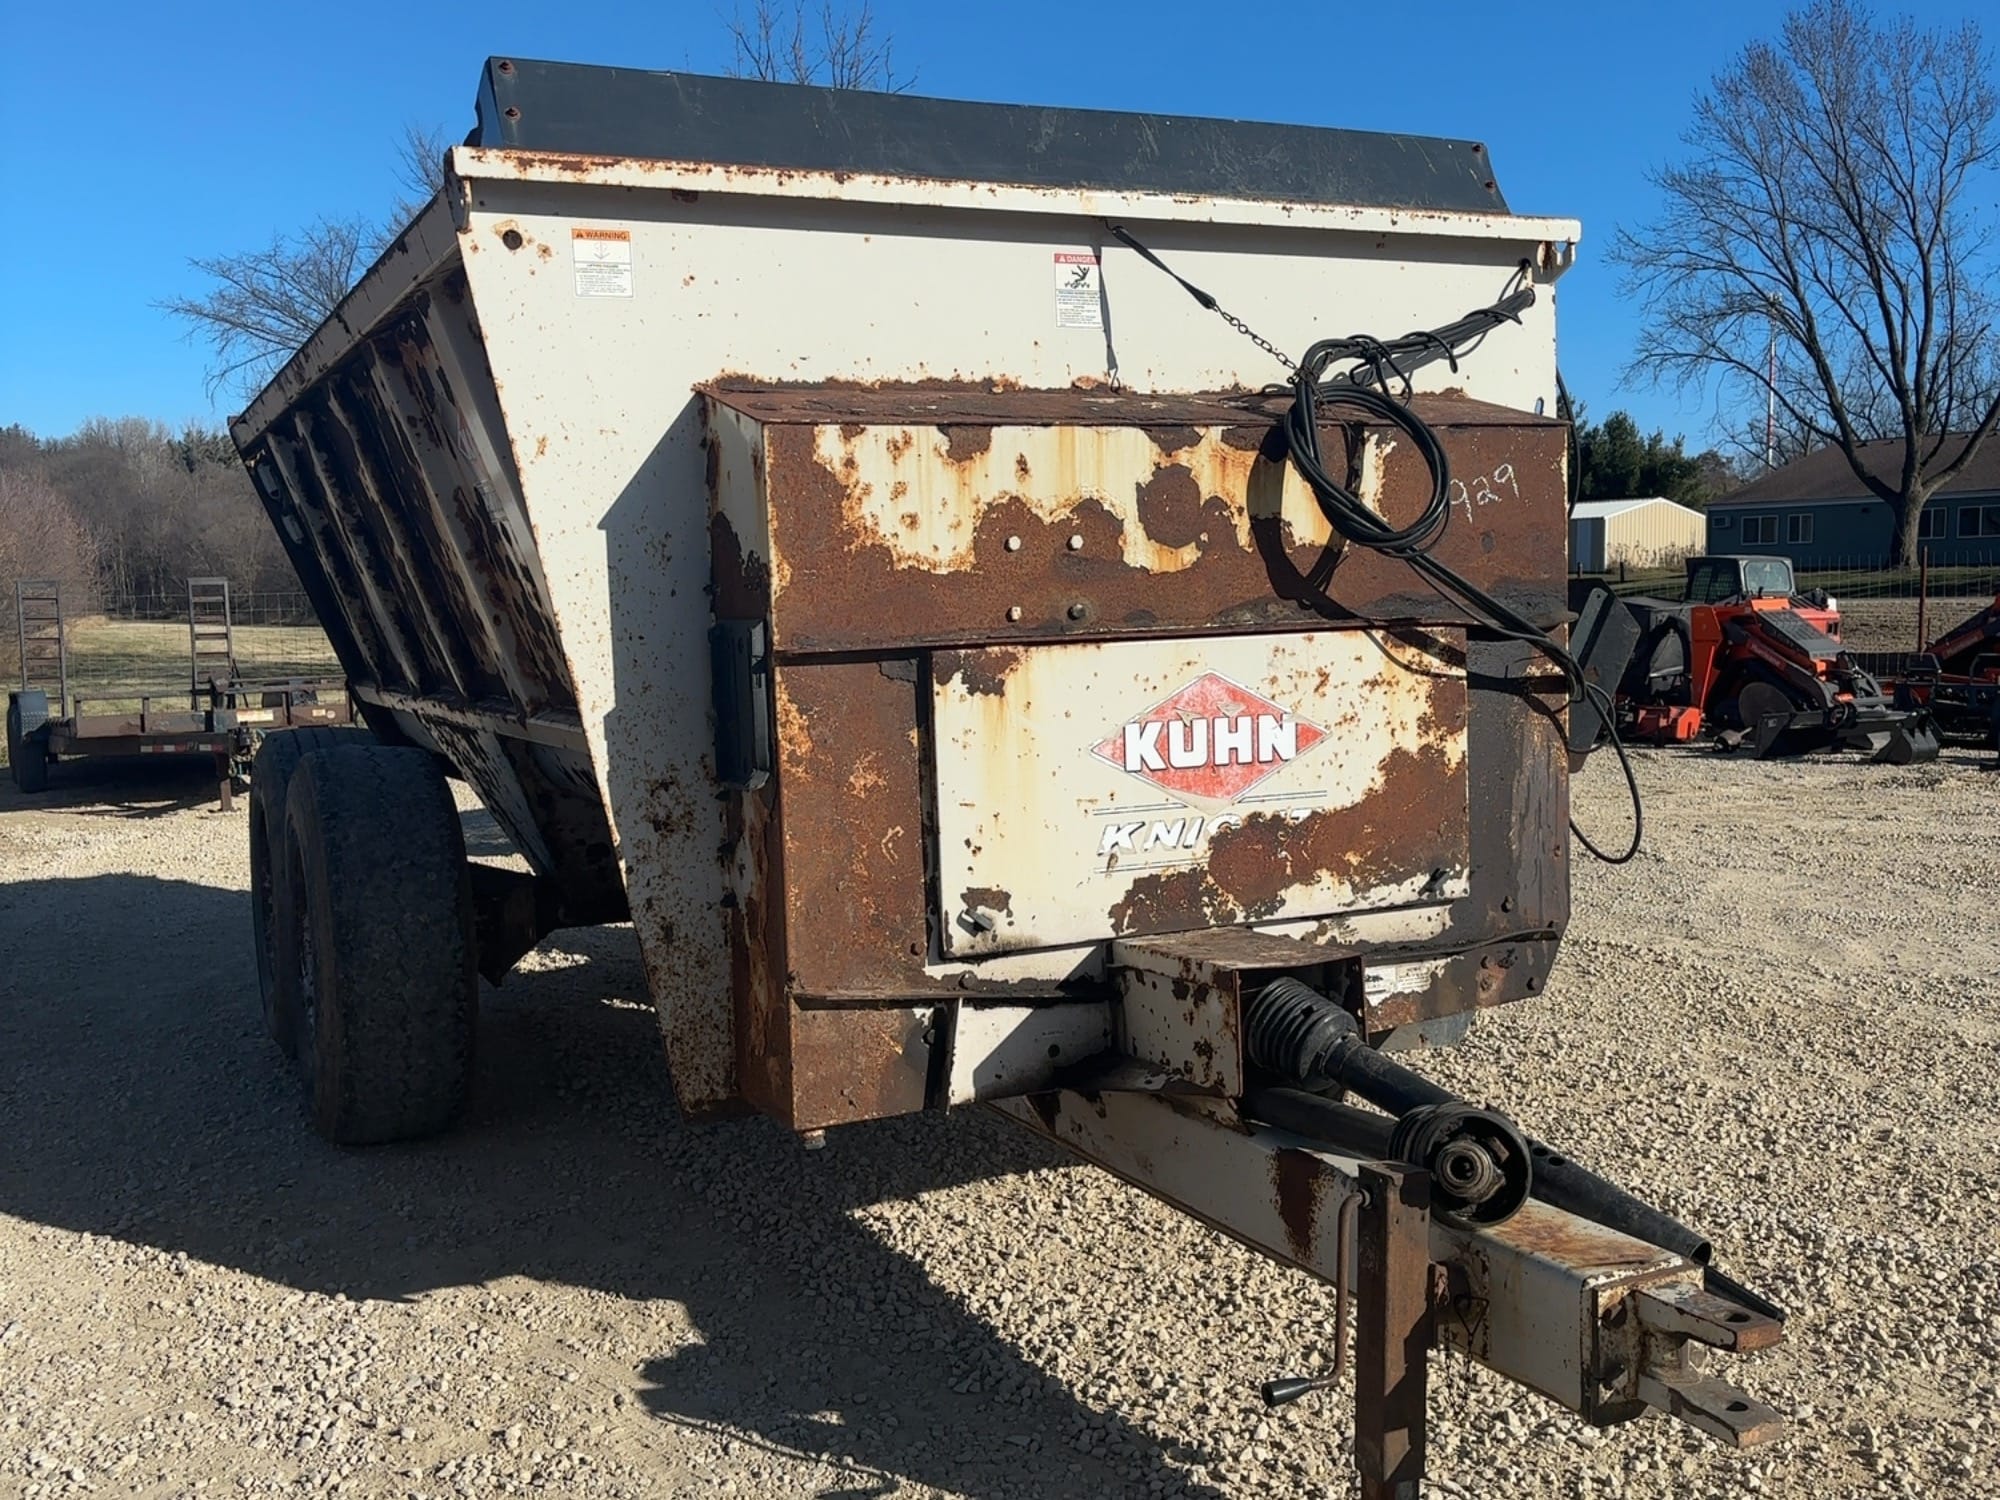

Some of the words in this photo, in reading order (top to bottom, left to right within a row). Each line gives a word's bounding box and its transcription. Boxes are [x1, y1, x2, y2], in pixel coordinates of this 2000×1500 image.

[585, 231, 627, 240] WARNING
[1066, 255, 1098, 265] DANGER
[1449, 463, 1520, 524] 929
[1123, 713, 1298, 773] KUHN
